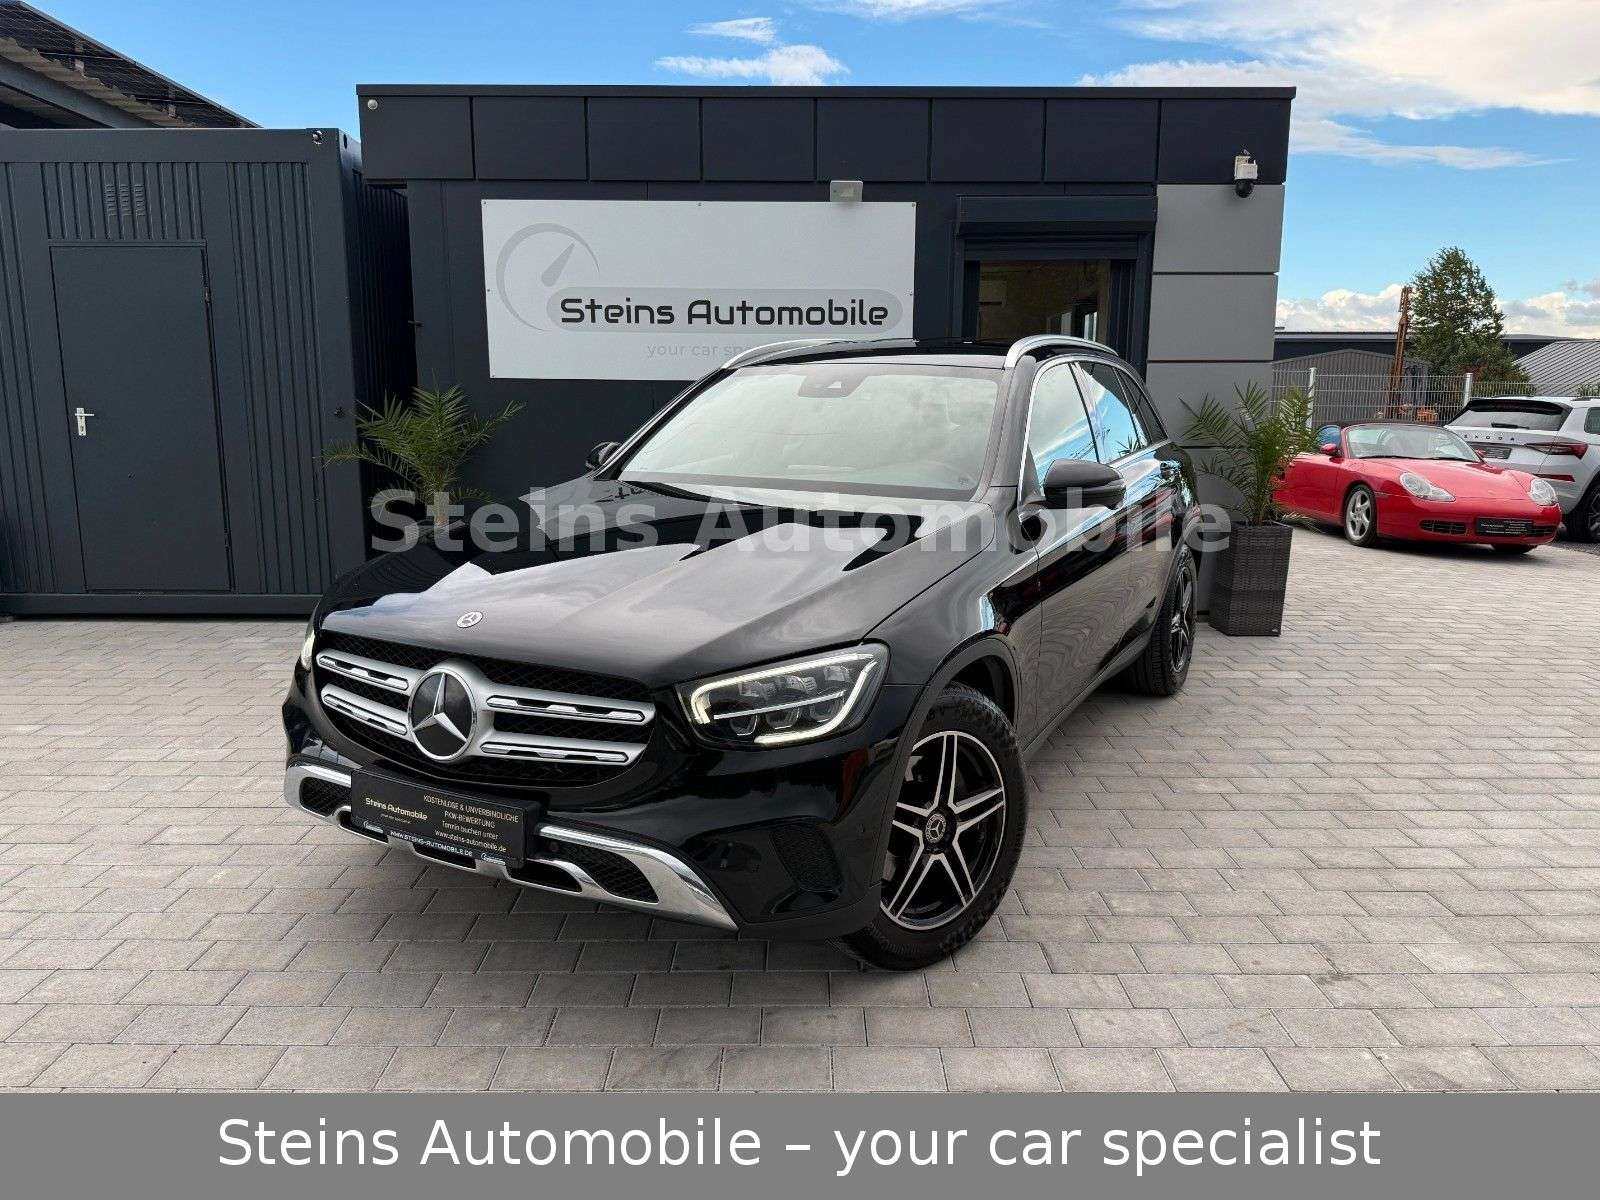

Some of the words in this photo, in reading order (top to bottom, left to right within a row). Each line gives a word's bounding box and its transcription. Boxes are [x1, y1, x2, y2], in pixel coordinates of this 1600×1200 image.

[560, 296, 675, 325] Steins
[687, 299, 889, 327] Automobile
[648, 344, 686, 357] your
[690, 344, 718, 356] car
[365, 797, 387, 810] Steins
[387, 804, 428, 820] Automobile
